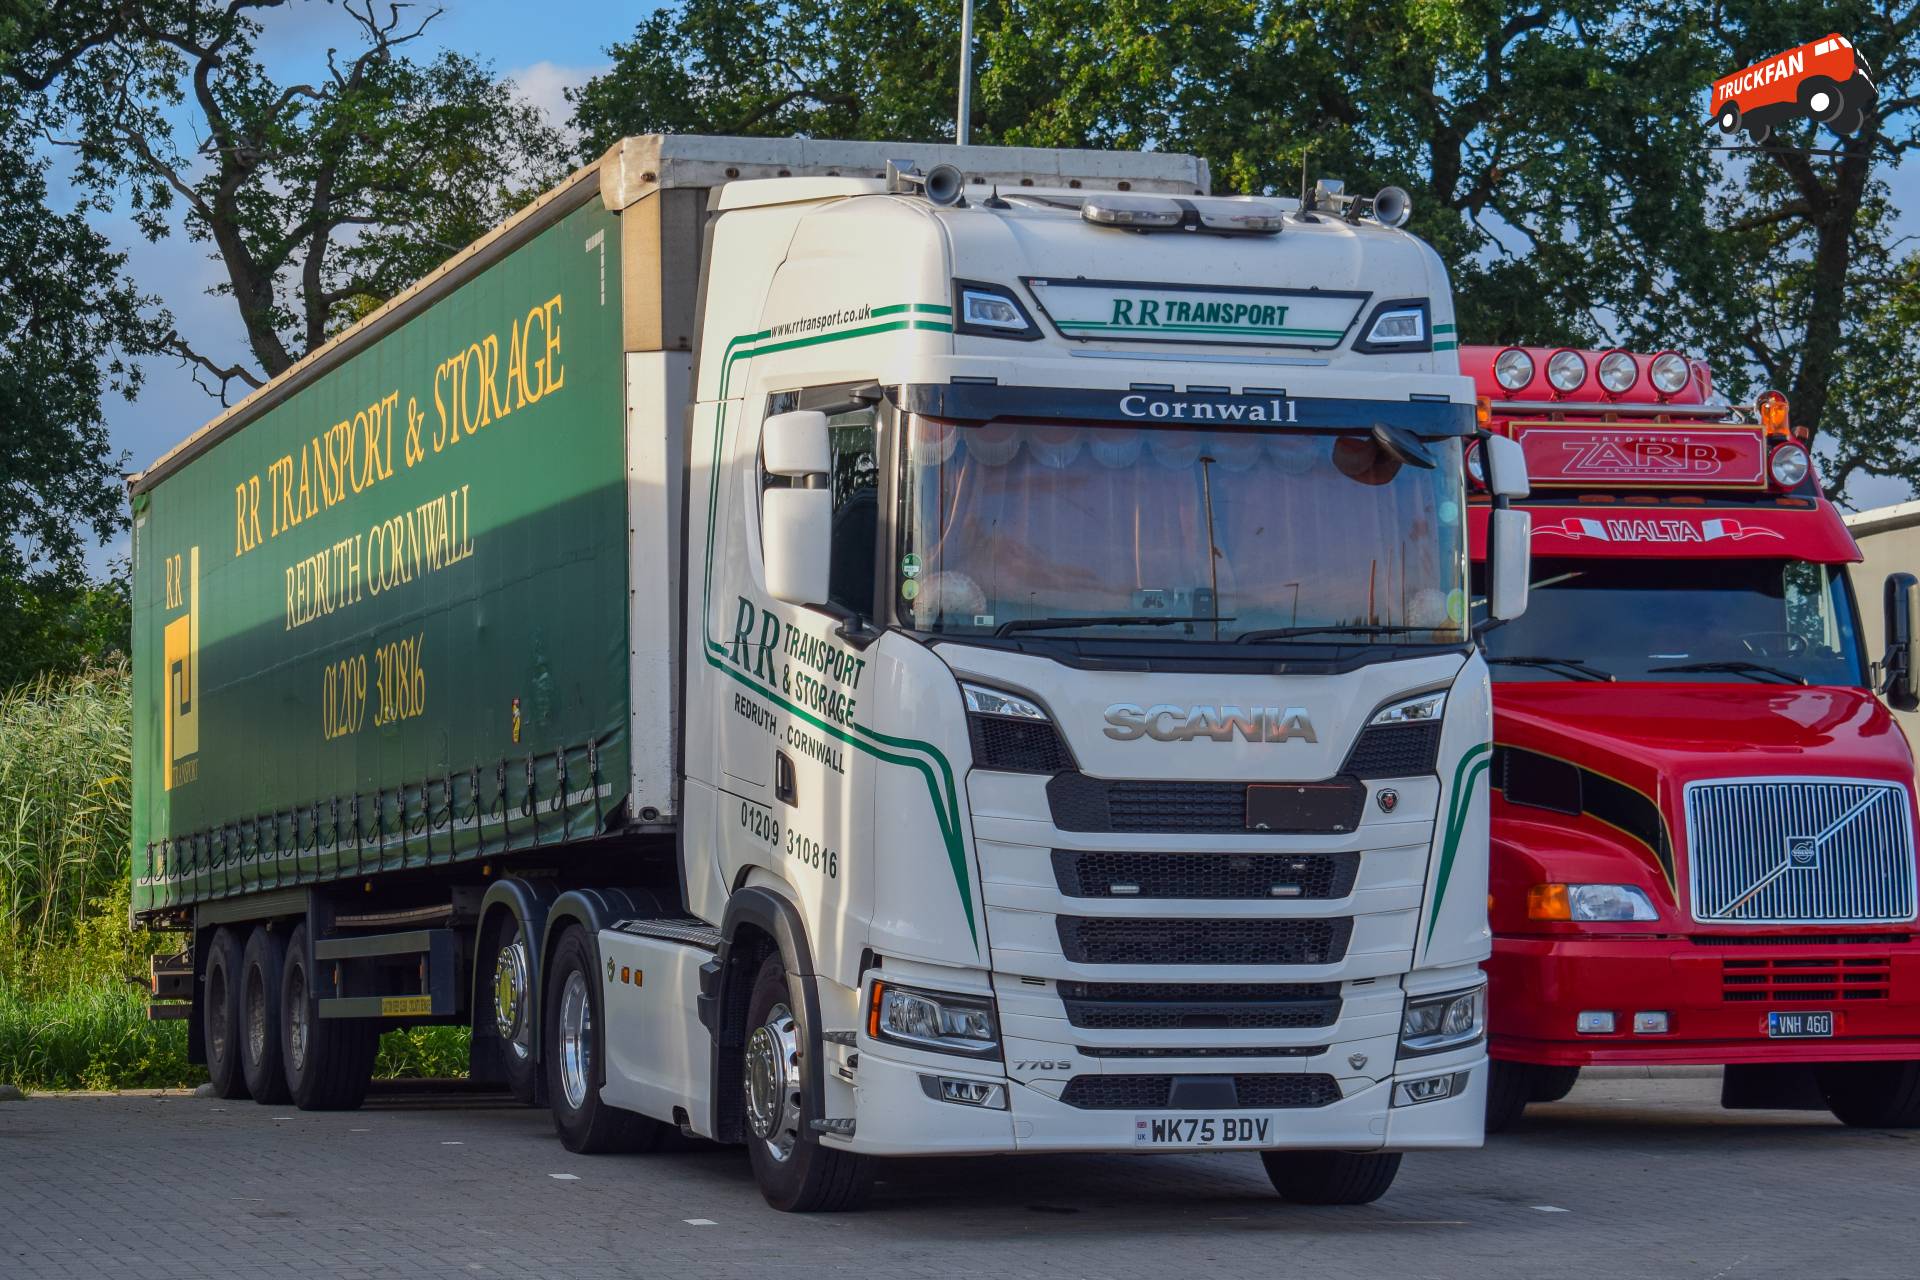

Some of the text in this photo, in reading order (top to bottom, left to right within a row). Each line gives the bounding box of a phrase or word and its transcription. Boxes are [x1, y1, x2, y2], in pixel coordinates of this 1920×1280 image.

[771, 303, 871, 338] www.rrtransport.co.uk
[1110, 299, 1290, 326] RR TRANSPORT
[235, 293, 564, 558] RR TRANSPORT & STORAGE
[1119, 395, 1299, 422] Cornwall
[1562, 442, 1722, 475] ZARB
[1606, 519, 1702, 543] MALTA
[165, 553, 183, 610] RR
[286, 484, 474, 632] REDRUTH CORNWALL
[729, 595, 866, 690] RR TRANSPORT
[323, 632, 426, 741] 01209 310816
[782, 663, 857, 730] & STORAGE
[734, 692, 845, 774] REDRUTH CORNWALL
[1102, 703, 1318, 743] SCANIA
[741, 801, 837, 879] 01209 310816
[1779, 1015, 1829, 1033] VNH 460
[1152, 1118, 1269, 1142] WK75 BDV
